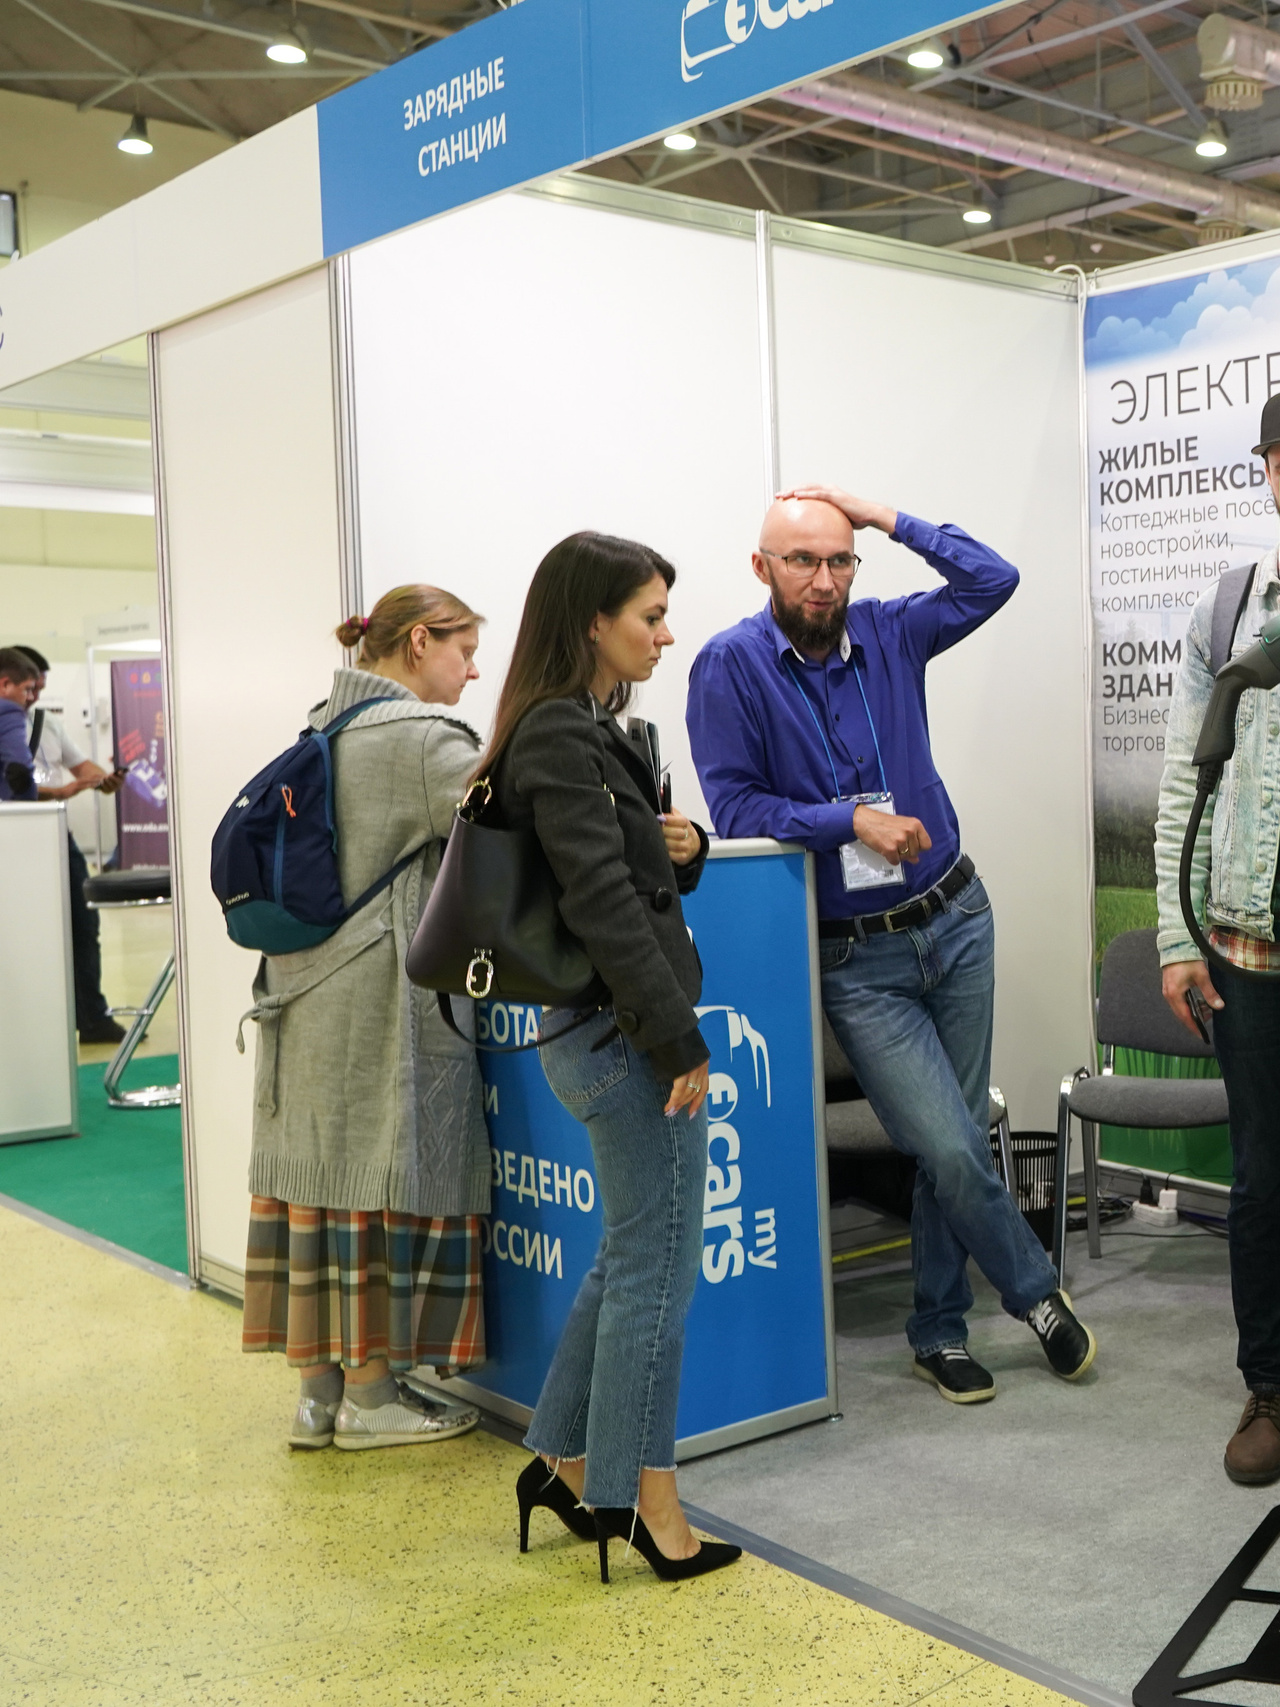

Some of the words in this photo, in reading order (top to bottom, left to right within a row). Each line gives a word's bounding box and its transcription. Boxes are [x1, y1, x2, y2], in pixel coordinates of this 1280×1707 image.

[403, 56, 505, 131] ЗАРЯДНЫЕ
[418, 112, 507, 177] СТАНЦИИ
[1098, 436, 1199, 475] ЖИЛЫЕ
[1100, 505, 1218, 533] Коттеджные
[1225, 492, 1277, 520] посё
[1100, 530, 1234, 559] новостройки,
[1101, 560, 1230, 586] гостиничные
[1103, 639, 1182, 667] КОММ
[1102, 673, 1173, 703] ЗДАН
[1103, 736, 1166, 756] торгов
[479, 1001, 541, 1047] БОТА
[491, 1148, 595, 1213] ВЕДЕНО
[481, 1216, 563, 1280] ОССИИ
[747, 1207, 778, 1270] my
